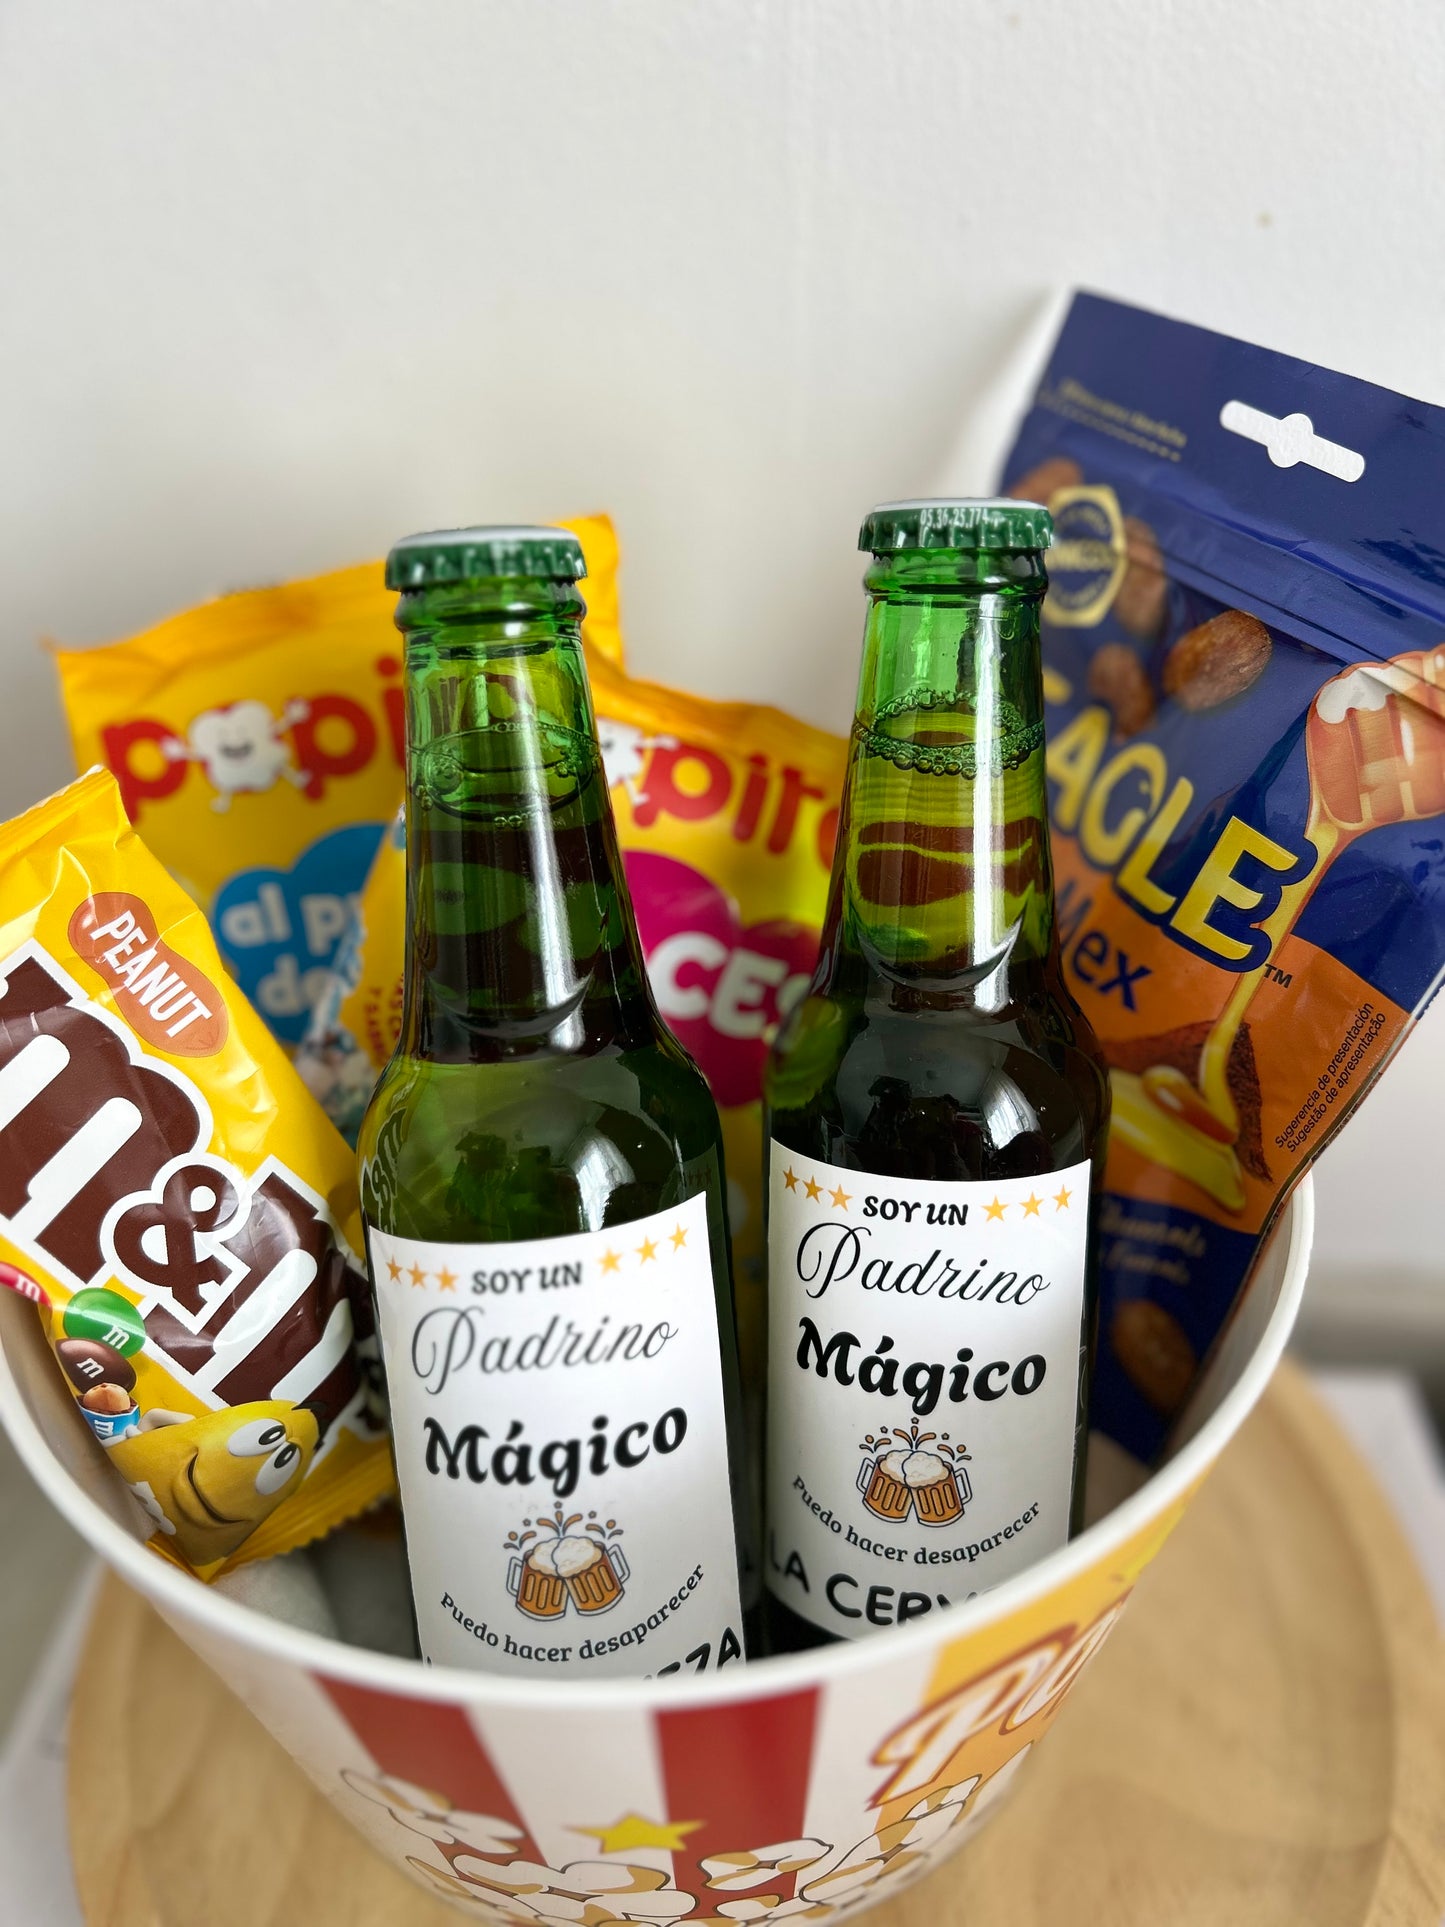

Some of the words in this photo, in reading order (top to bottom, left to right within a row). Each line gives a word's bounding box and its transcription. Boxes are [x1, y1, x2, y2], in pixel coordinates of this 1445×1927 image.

[101, 655, 406, 828] popi
[1043, 670, 1300, 962] AGLE
[89, 908, 213, 1042] PEANUT
[1264, 963, 1293, 989] TM
[1275, 1089, 1320, 1148] Sugerencia
[1317, 1073, 1331, 1091] de
[1327, 1002, 1374, 1078] presentación
[1286, 1103, 1327, 1153] Sugestão
[1325, 1086, 1338, 1104] de
[1335, 1012, 1386, 1089] apresentação
[863, 1195, 921, 1223] SOY
[927, 1202, 969, 1226] UN
[472, 1266, 532, 1295] SOY
[540, 1262, 583, 1290] UN
[796, 1222, 1051, 1306] Padrino
[77, 1357, 104, 1379] m
[102, 1325, 130, 1349] m
[411, 1307, 679, 1395] Padrino
[797, 1316, 1047, 1416] Mágico
[423, 1407, 688, 1498] Mágico
[793, 1475, 842, 1534] Puedo
[845, 1524, 908, 1562] hacer
[914, 1501, 1040, 1565] desaparecer
[440, 1592, 499, 1647] Puedo
[503, 1635, 572, 1662] hacer
[579, 1564, 705, 1660] desaparecer
[825, 1572, 978, 1626] CER
